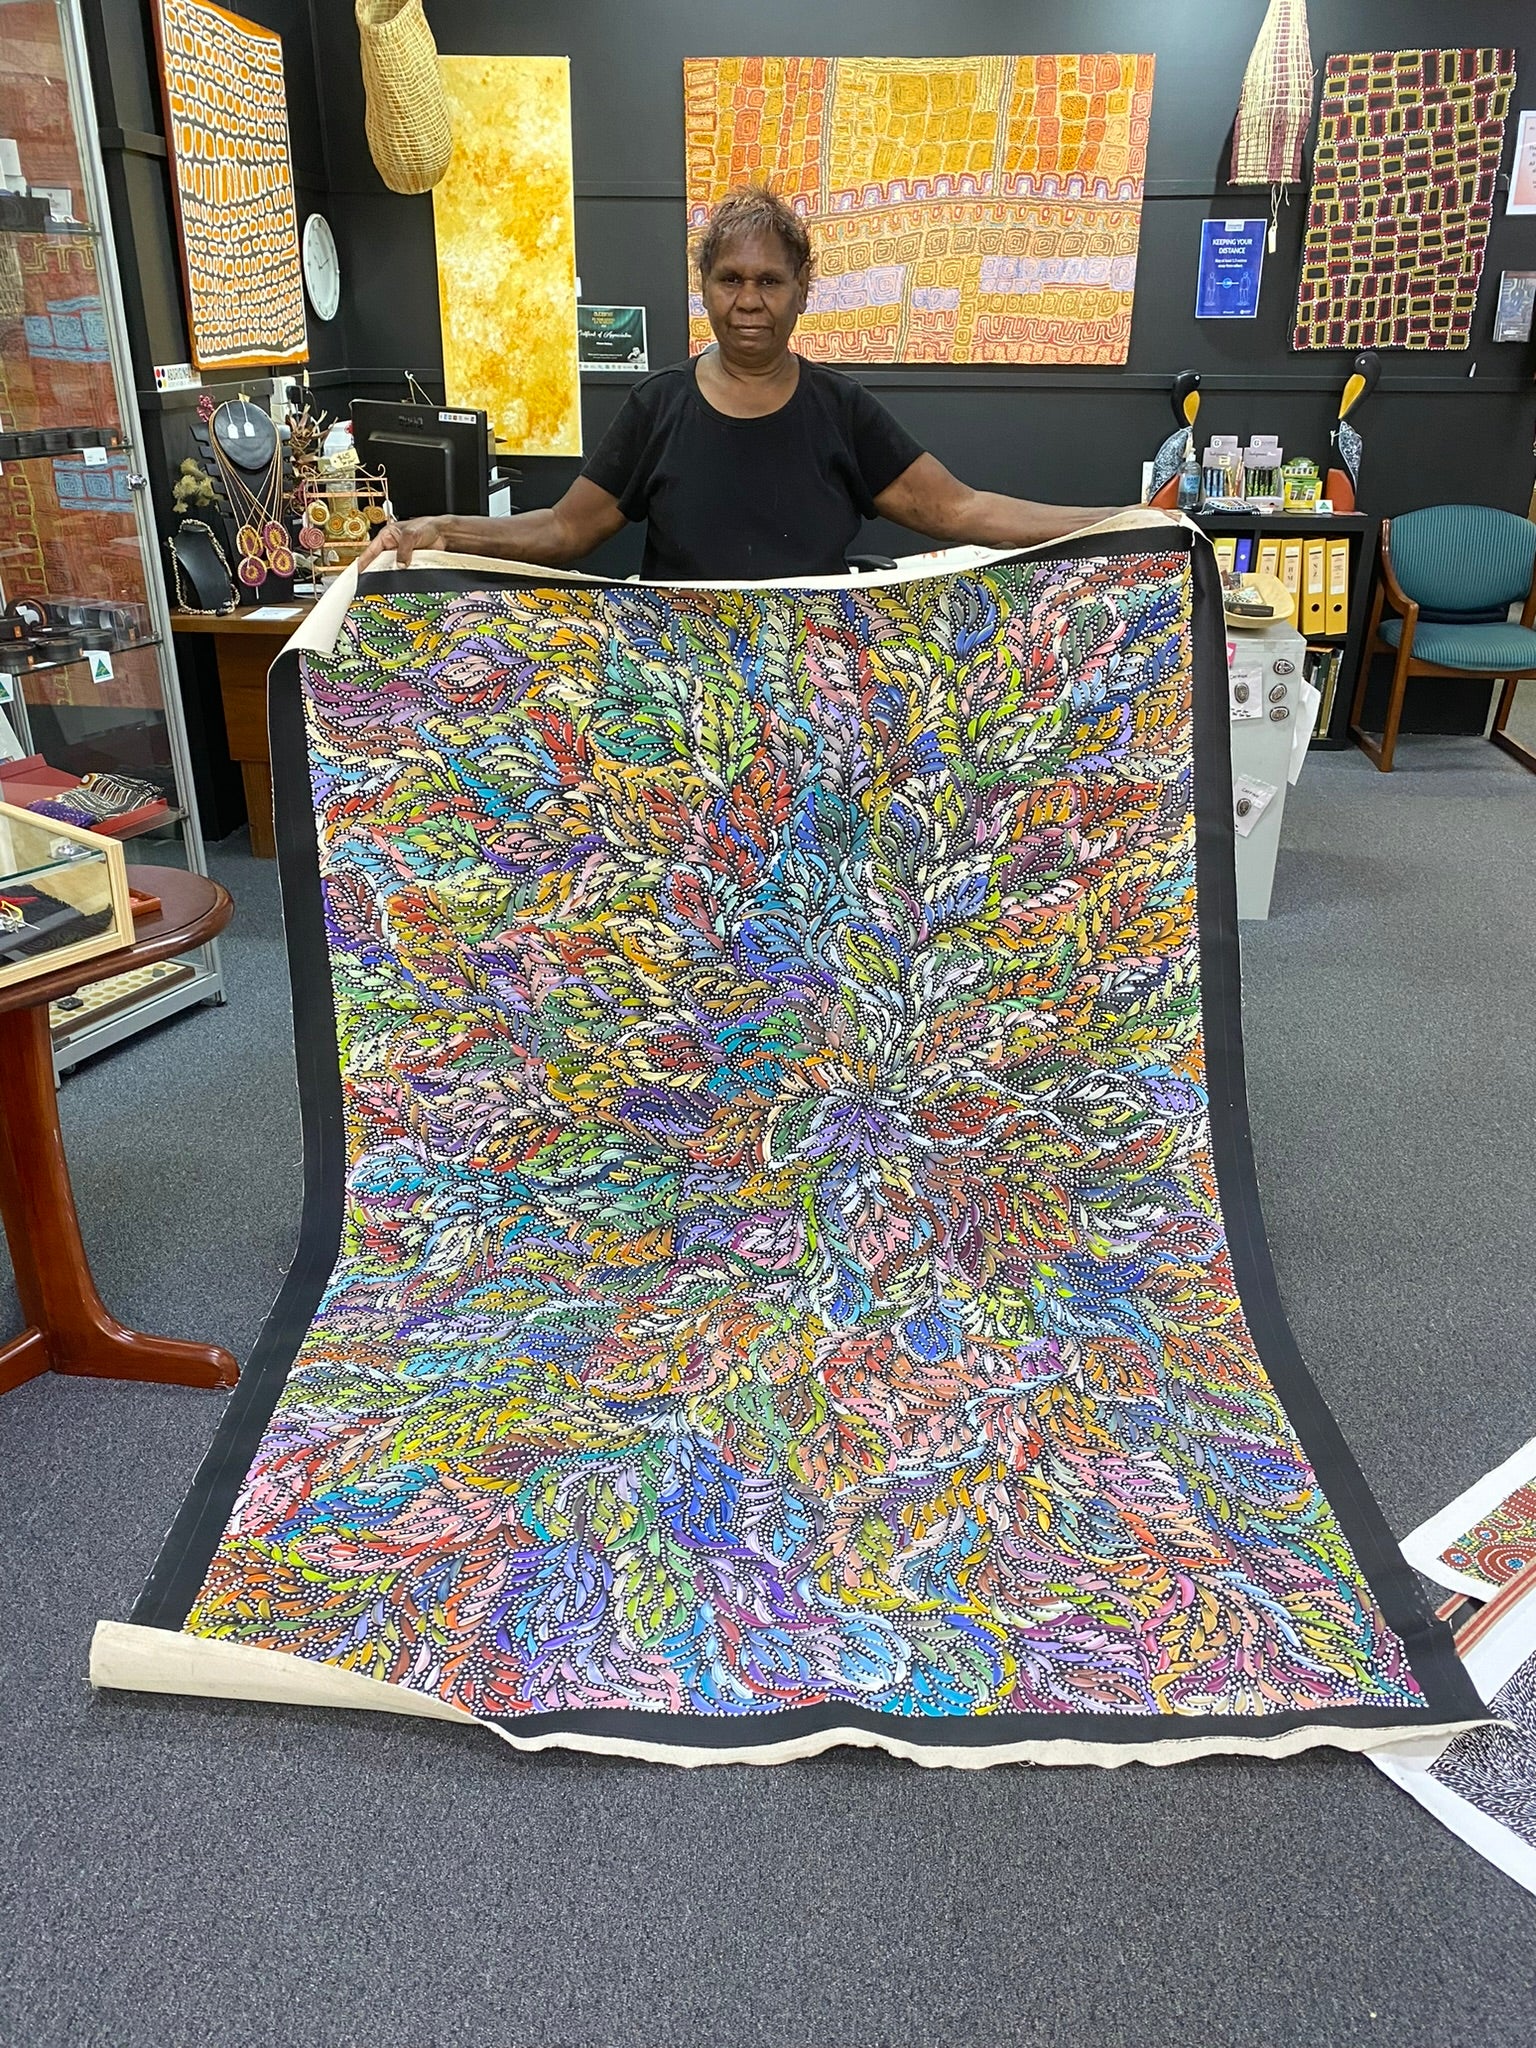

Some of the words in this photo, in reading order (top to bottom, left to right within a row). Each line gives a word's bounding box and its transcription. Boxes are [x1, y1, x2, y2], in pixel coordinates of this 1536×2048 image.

[1212, 238, 1236, 246] KEEPING
[1236, 238, 1253, 246] YOUR
[1218, 247, 1246, 255] DISTANCE
